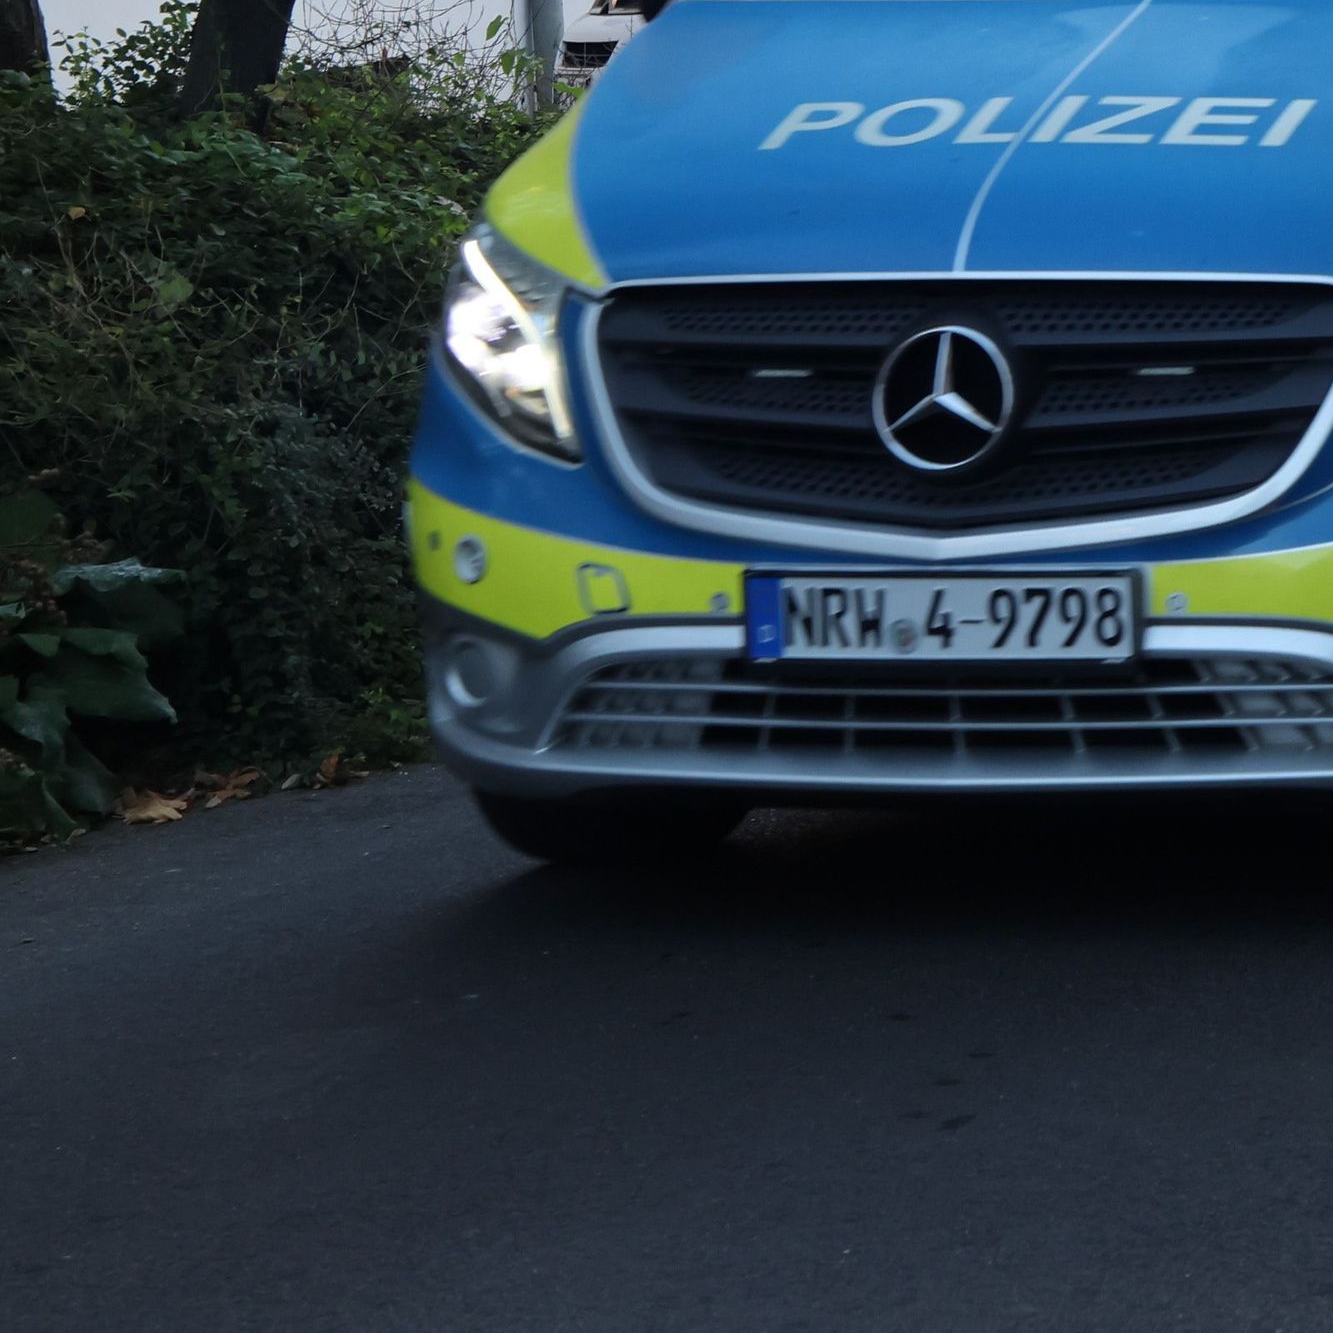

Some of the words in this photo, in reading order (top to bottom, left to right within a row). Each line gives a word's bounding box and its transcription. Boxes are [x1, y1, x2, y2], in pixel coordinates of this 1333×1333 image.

[758, 95, 1319, 150] POLIZEI
[783, 586, 887, 649] NRW
[926, 587, 1126, 649] 4-9798
